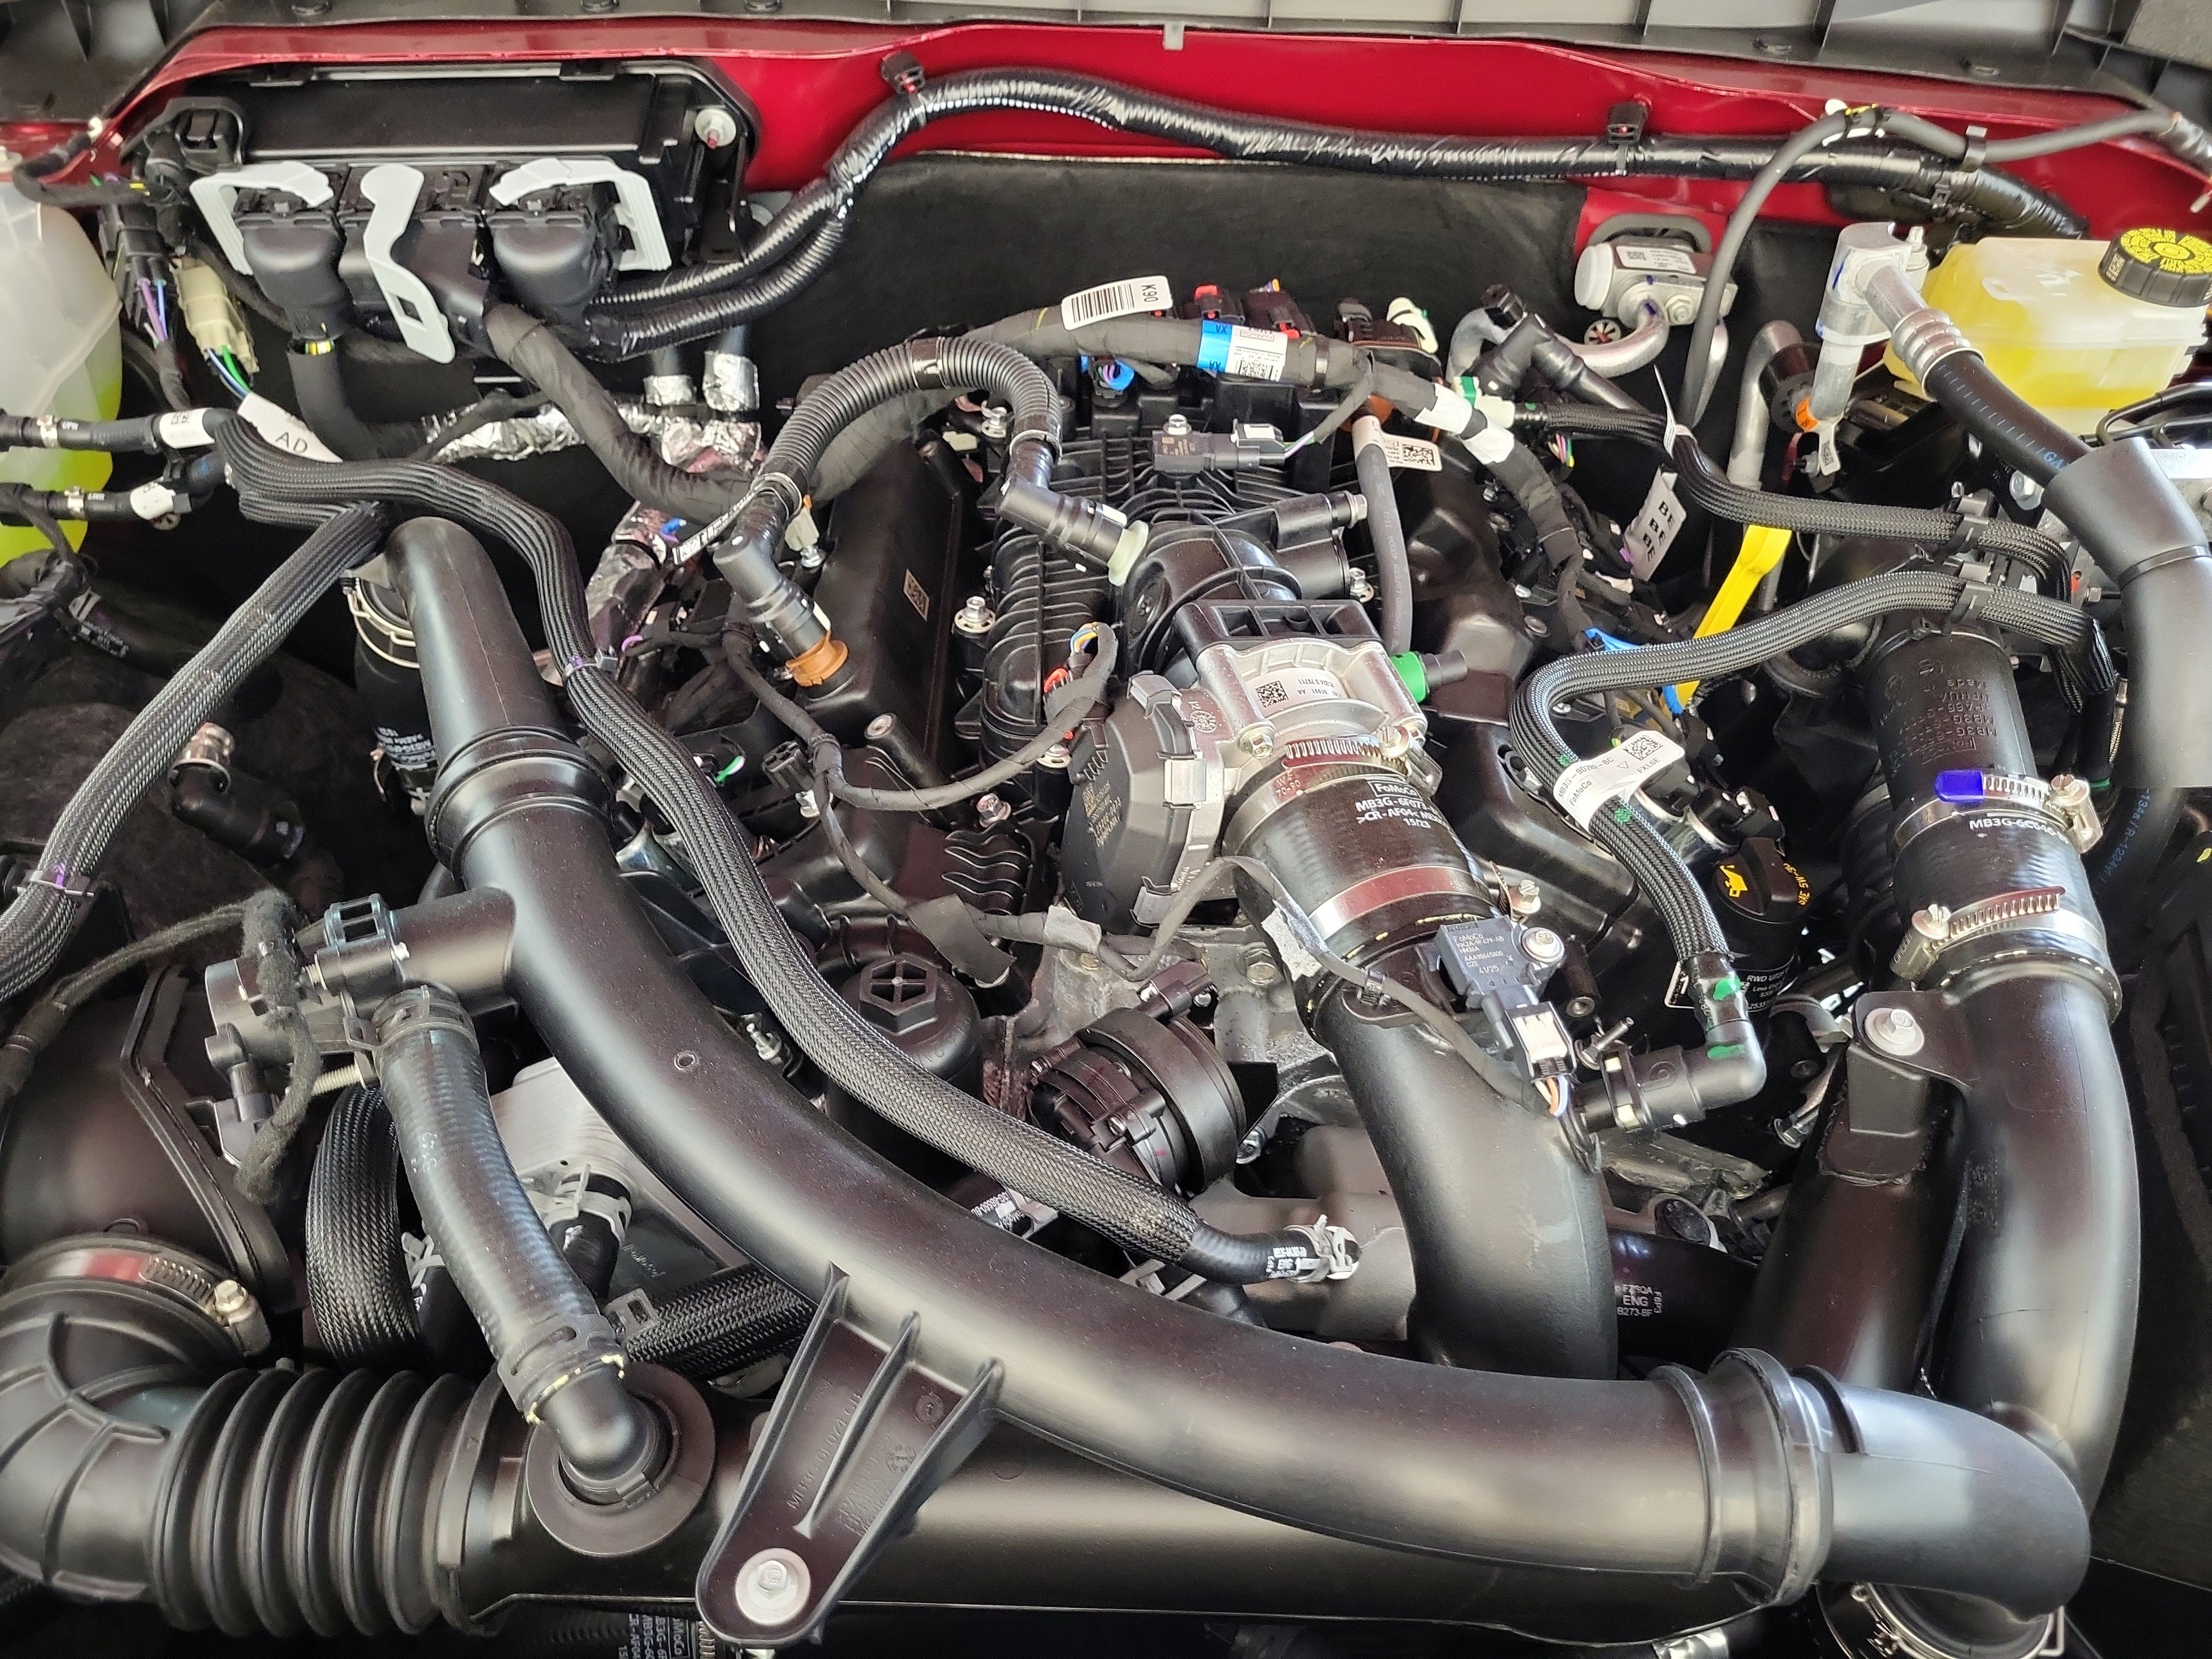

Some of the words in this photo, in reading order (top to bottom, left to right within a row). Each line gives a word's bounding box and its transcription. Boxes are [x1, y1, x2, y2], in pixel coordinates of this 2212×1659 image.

[1141, 284, 1159, 302] K90
[275, 431, 307, 453] AD
[1658, 500, 1674, 530] BE
[1649, 517, 1666, 541] BE
[1642, 533, 1655, 562] BE
[1375, 782, 1418, 796] FoMoCo
[1569, 780, 1593, 807] FoMoCo
[2132, 788, 2151, 820] -134a
[1403, 818, 1431, 829] 15/23
[1798, 889, 1810, 906] SAE
[1453, 932, 1484, 942] FoMoCo
[1746, 974, 1767, 983] RWD
[1623, 1295, 1648, 1306] ENG
[1616, 1306, 1653, 1317] B273-BF
[672, 1617, 685, 1655] MoCo
